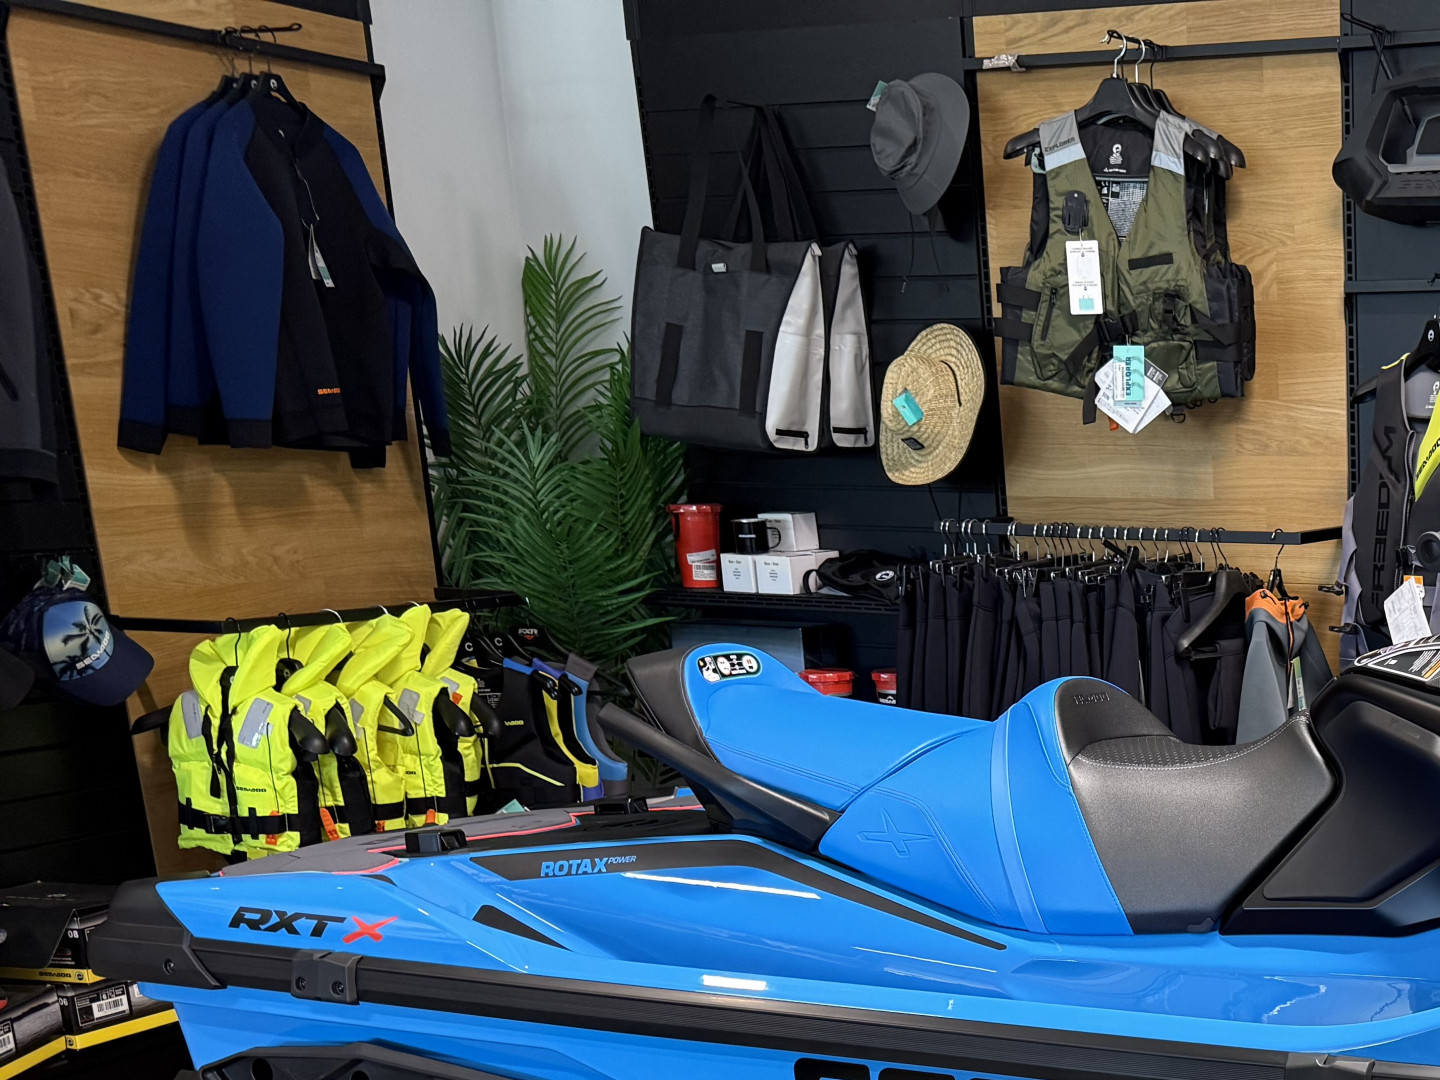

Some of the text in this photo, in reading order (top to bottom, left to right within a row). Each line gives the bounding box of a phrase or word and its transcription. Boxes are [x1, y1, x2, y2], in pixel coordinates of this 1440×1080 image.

[540, 855, 637, 877] ROTAX POWER
[227, 906, 347, 938] RXT
